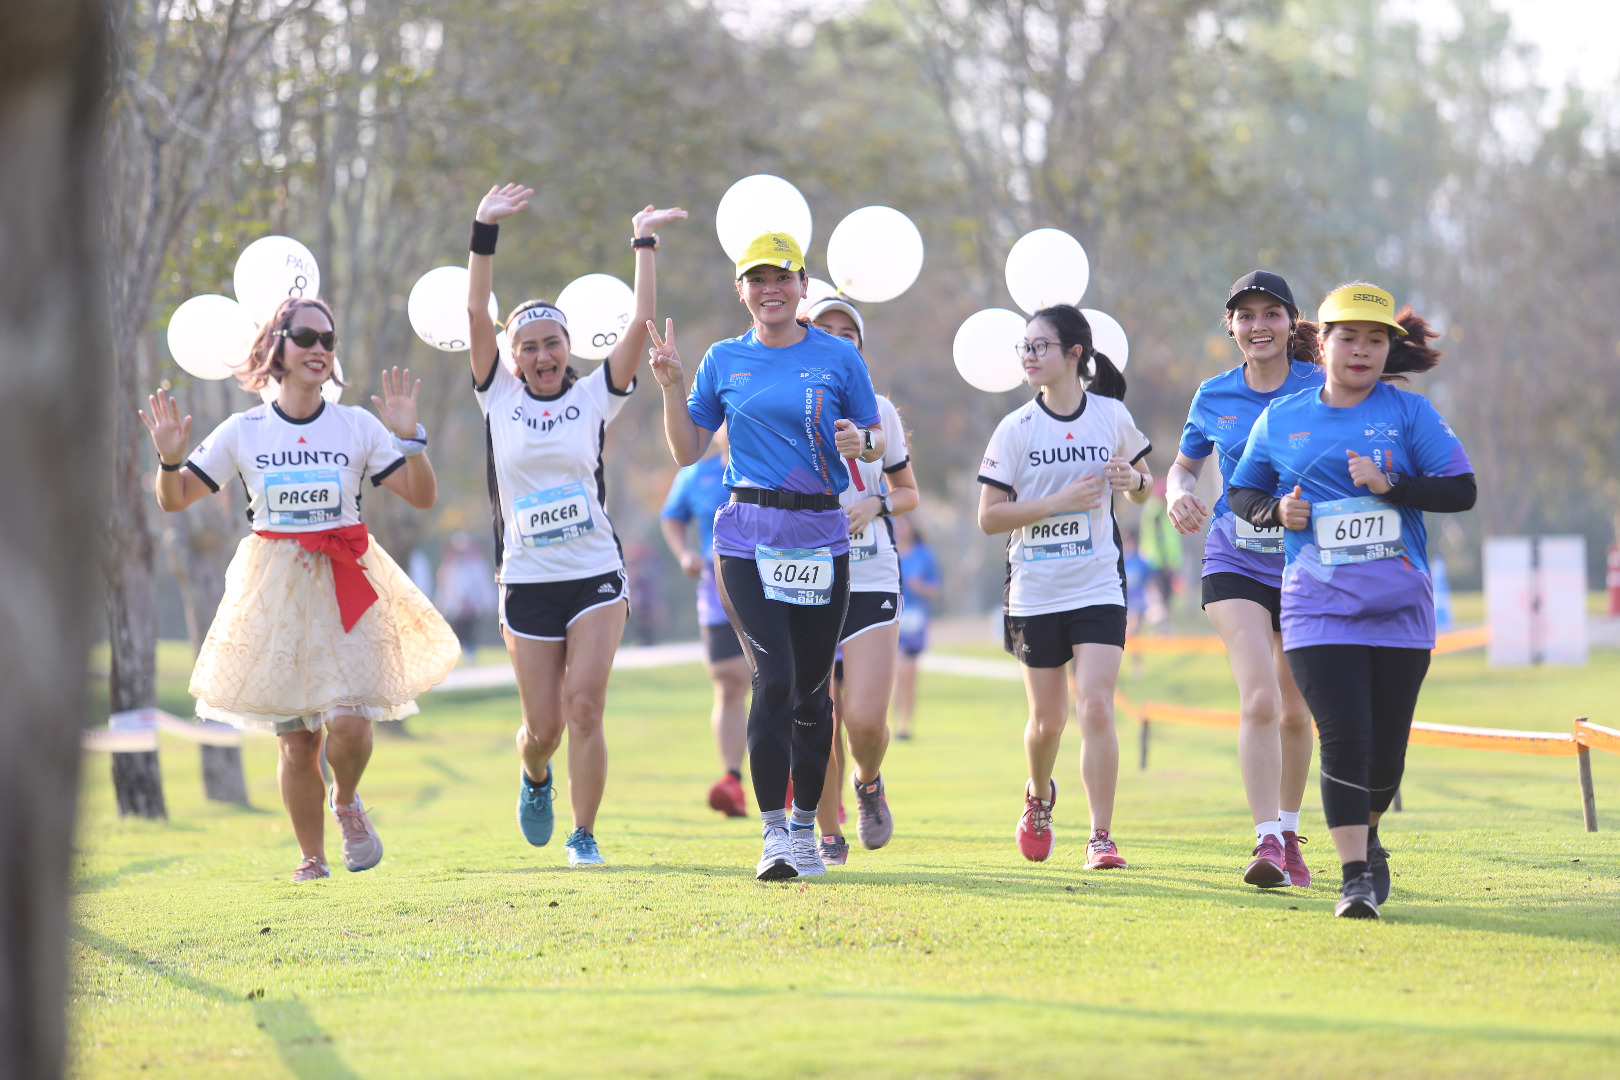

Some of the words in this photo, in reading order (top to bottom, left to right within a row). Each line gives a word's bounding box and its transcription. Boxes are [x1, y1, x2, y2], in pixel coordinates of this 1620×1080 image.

[289, 275, 307, 298] 8
[1353, 293, 1388, 307] SEIKO
[518, 308, 553, 325] FILA
[592, 332, 618, 348] 8
[805, 387, 813, 415] CROSS
[813, 388, 824, 425] SINGHA
[1387, 429, 1399, 437] XC
[256, 450, 349, 470] SUUNTO
[1029, 446, 1110, 467] SUUNTO
[1373, 448, 1382, 472] CRO
[1384, 448, 1394, 474] SING
[279, 488, 329, 505] PACER
[530, 504, 578, 528] PACER
[1031, 521, 1079, 539] PACER
[1335, 515, 1384, 541] 6071
[773, 564, 819, 584] 6041
